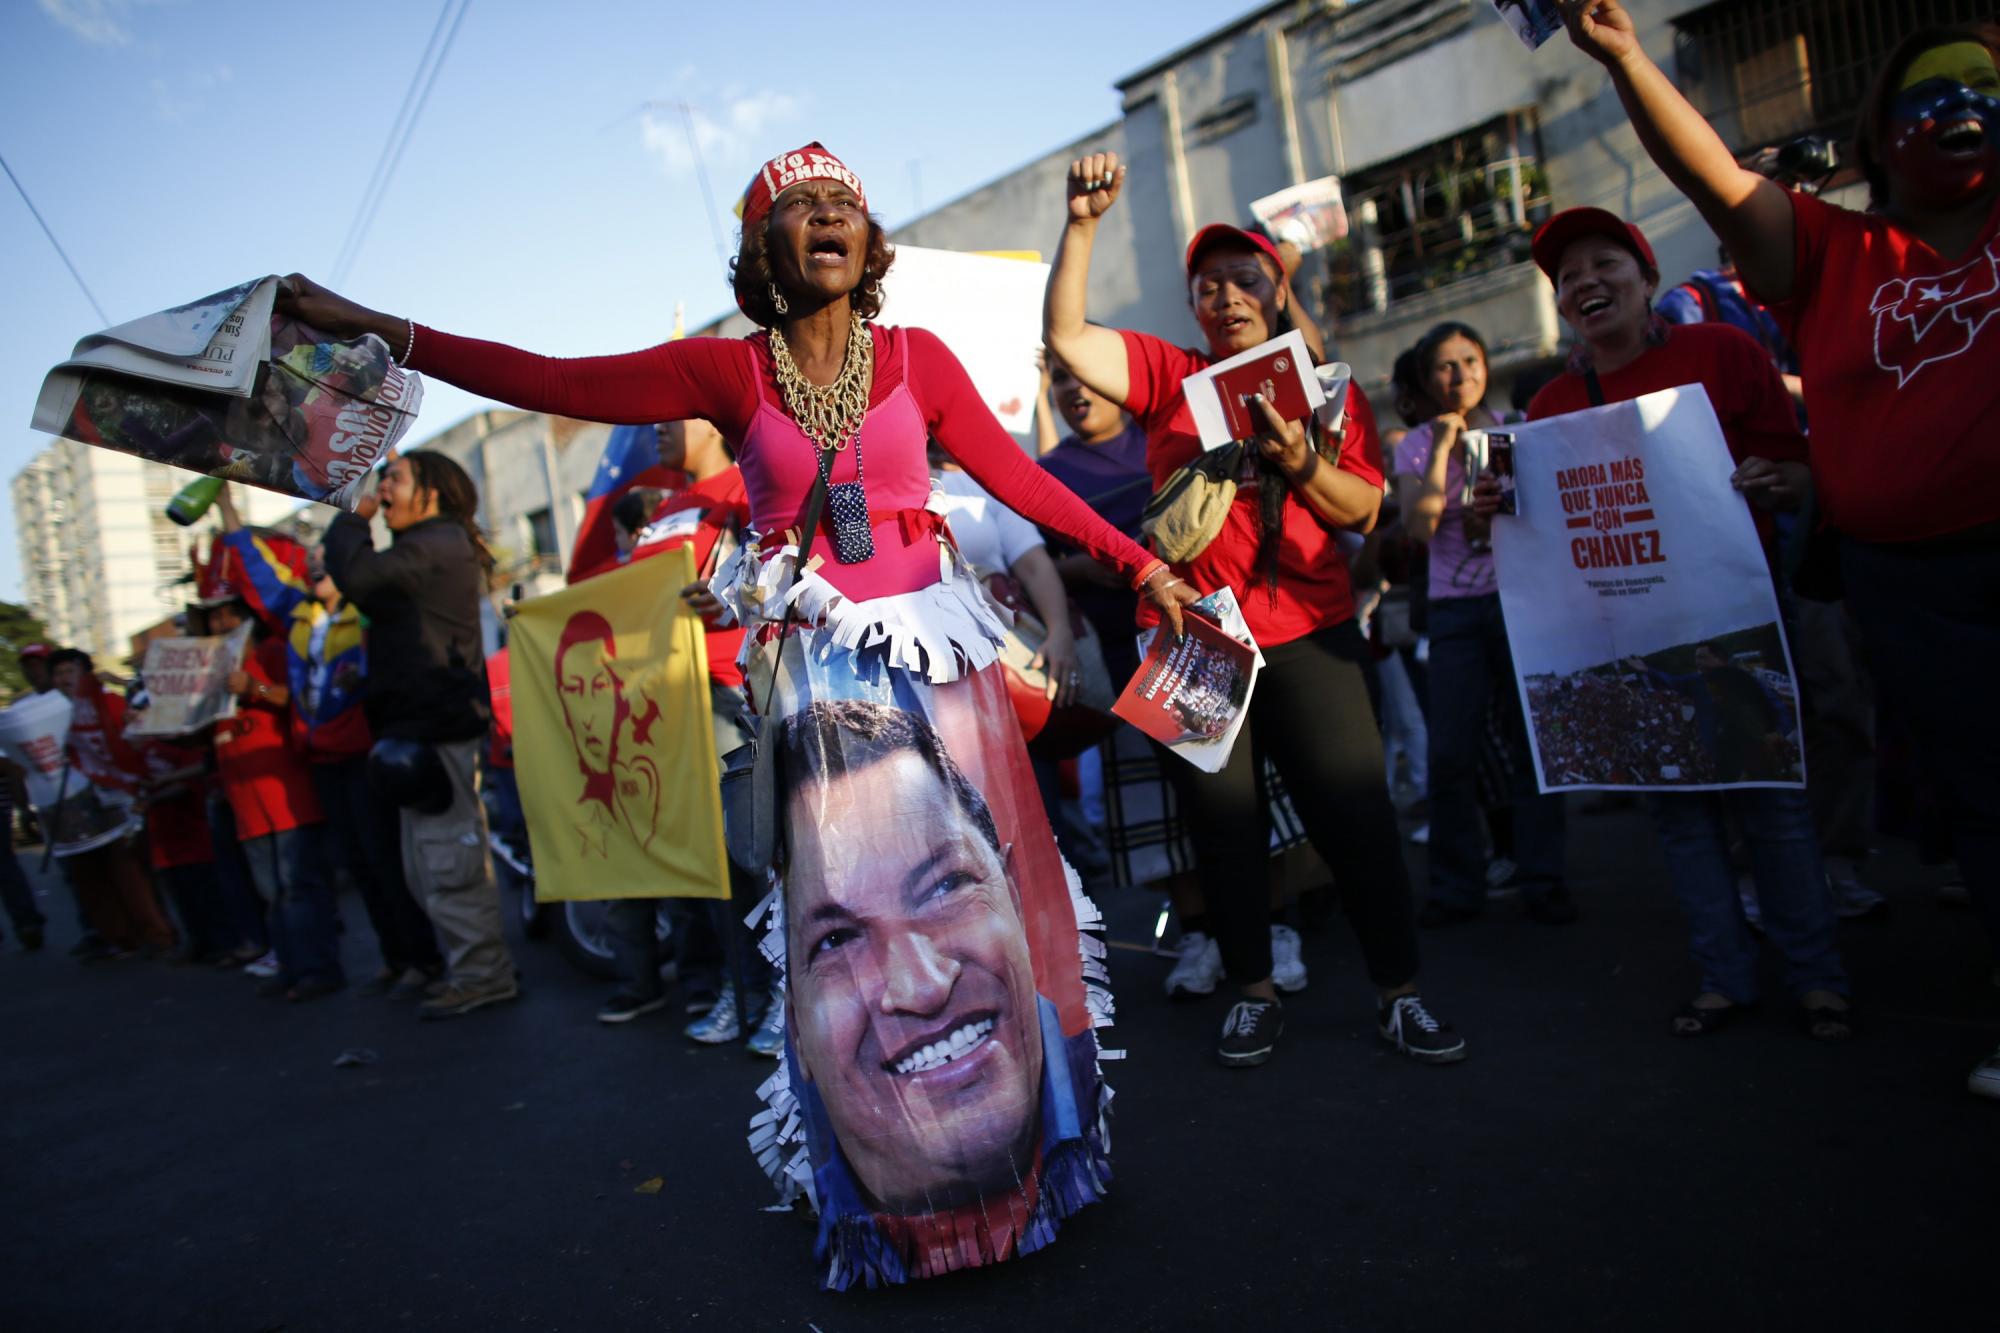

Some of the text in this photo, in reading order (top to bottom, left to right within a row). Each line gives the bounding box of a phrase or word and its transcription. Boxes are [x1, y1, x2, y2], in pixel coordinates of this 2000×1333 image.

[774, 153, 805, 174] YO
[780, 163, 861, 196] CHAVEZ
[225, 325, 241, 337] Sin
[230, 314, 245, 326] los
[1556, 456, 1644, 491] AHORA MÁS
[1561, 481, 1650, 514] QUE NUNCA
[1593, 508, 1622, 531] CON
[1193, 638, 1202, 656] LAS
[1145, 646, 1179, 700] PRESIDENTE
[1163, 633, 1194, 693] ADMIRABLES
